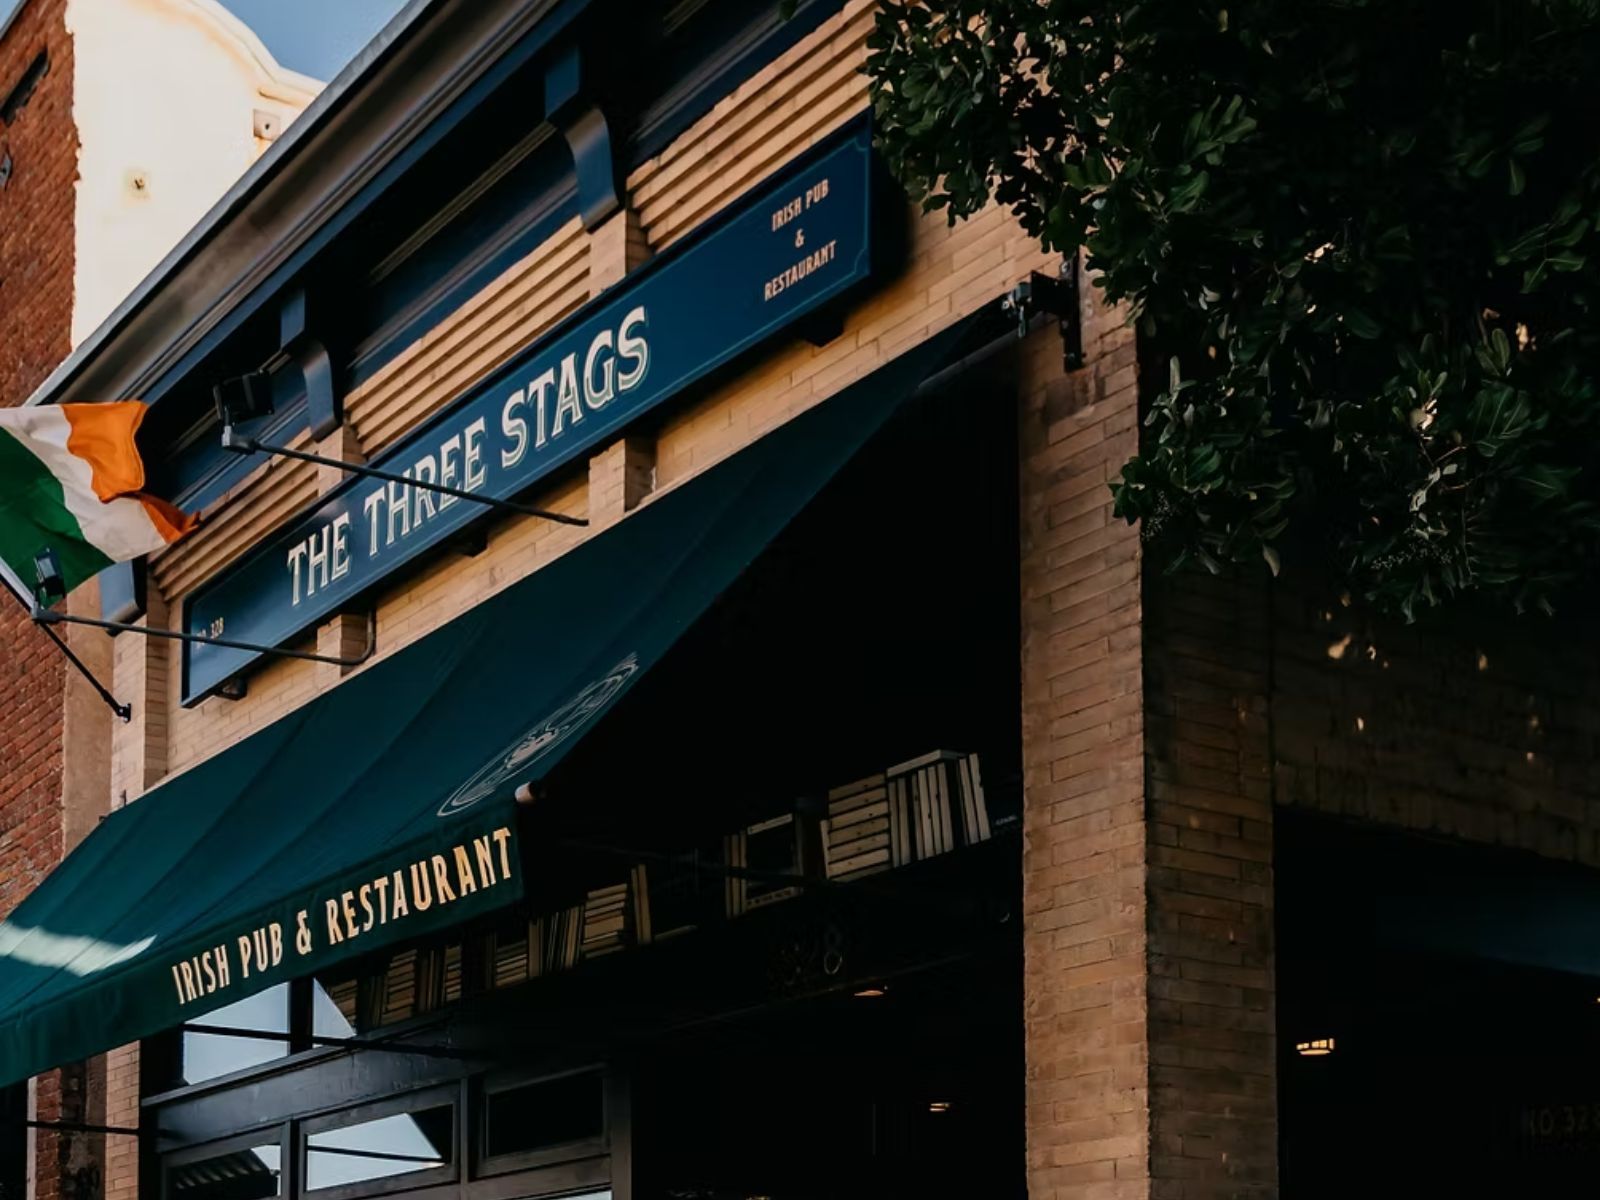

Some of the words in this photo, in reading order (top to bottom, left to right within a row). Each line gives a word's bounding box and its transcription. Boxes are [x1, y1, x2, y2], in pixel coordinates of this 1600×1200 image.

[772, 196, 802, 232] IRISH
[805, 178, 829, 209] PUB
[795, 228, 805, 248] &
[764, 240, 836, 302] RESTAURANT
[286, 511, 352, 607] THE
[363, 416, 489, 557] THREE
[501, 305, 649, 469] STAGS
[171, 944, 231, 1005] IRISH
[238, 922, 283, 978] PUB
[295, 909, 312, 955] &
[325, 826, 512, 945] RESTAURANT
